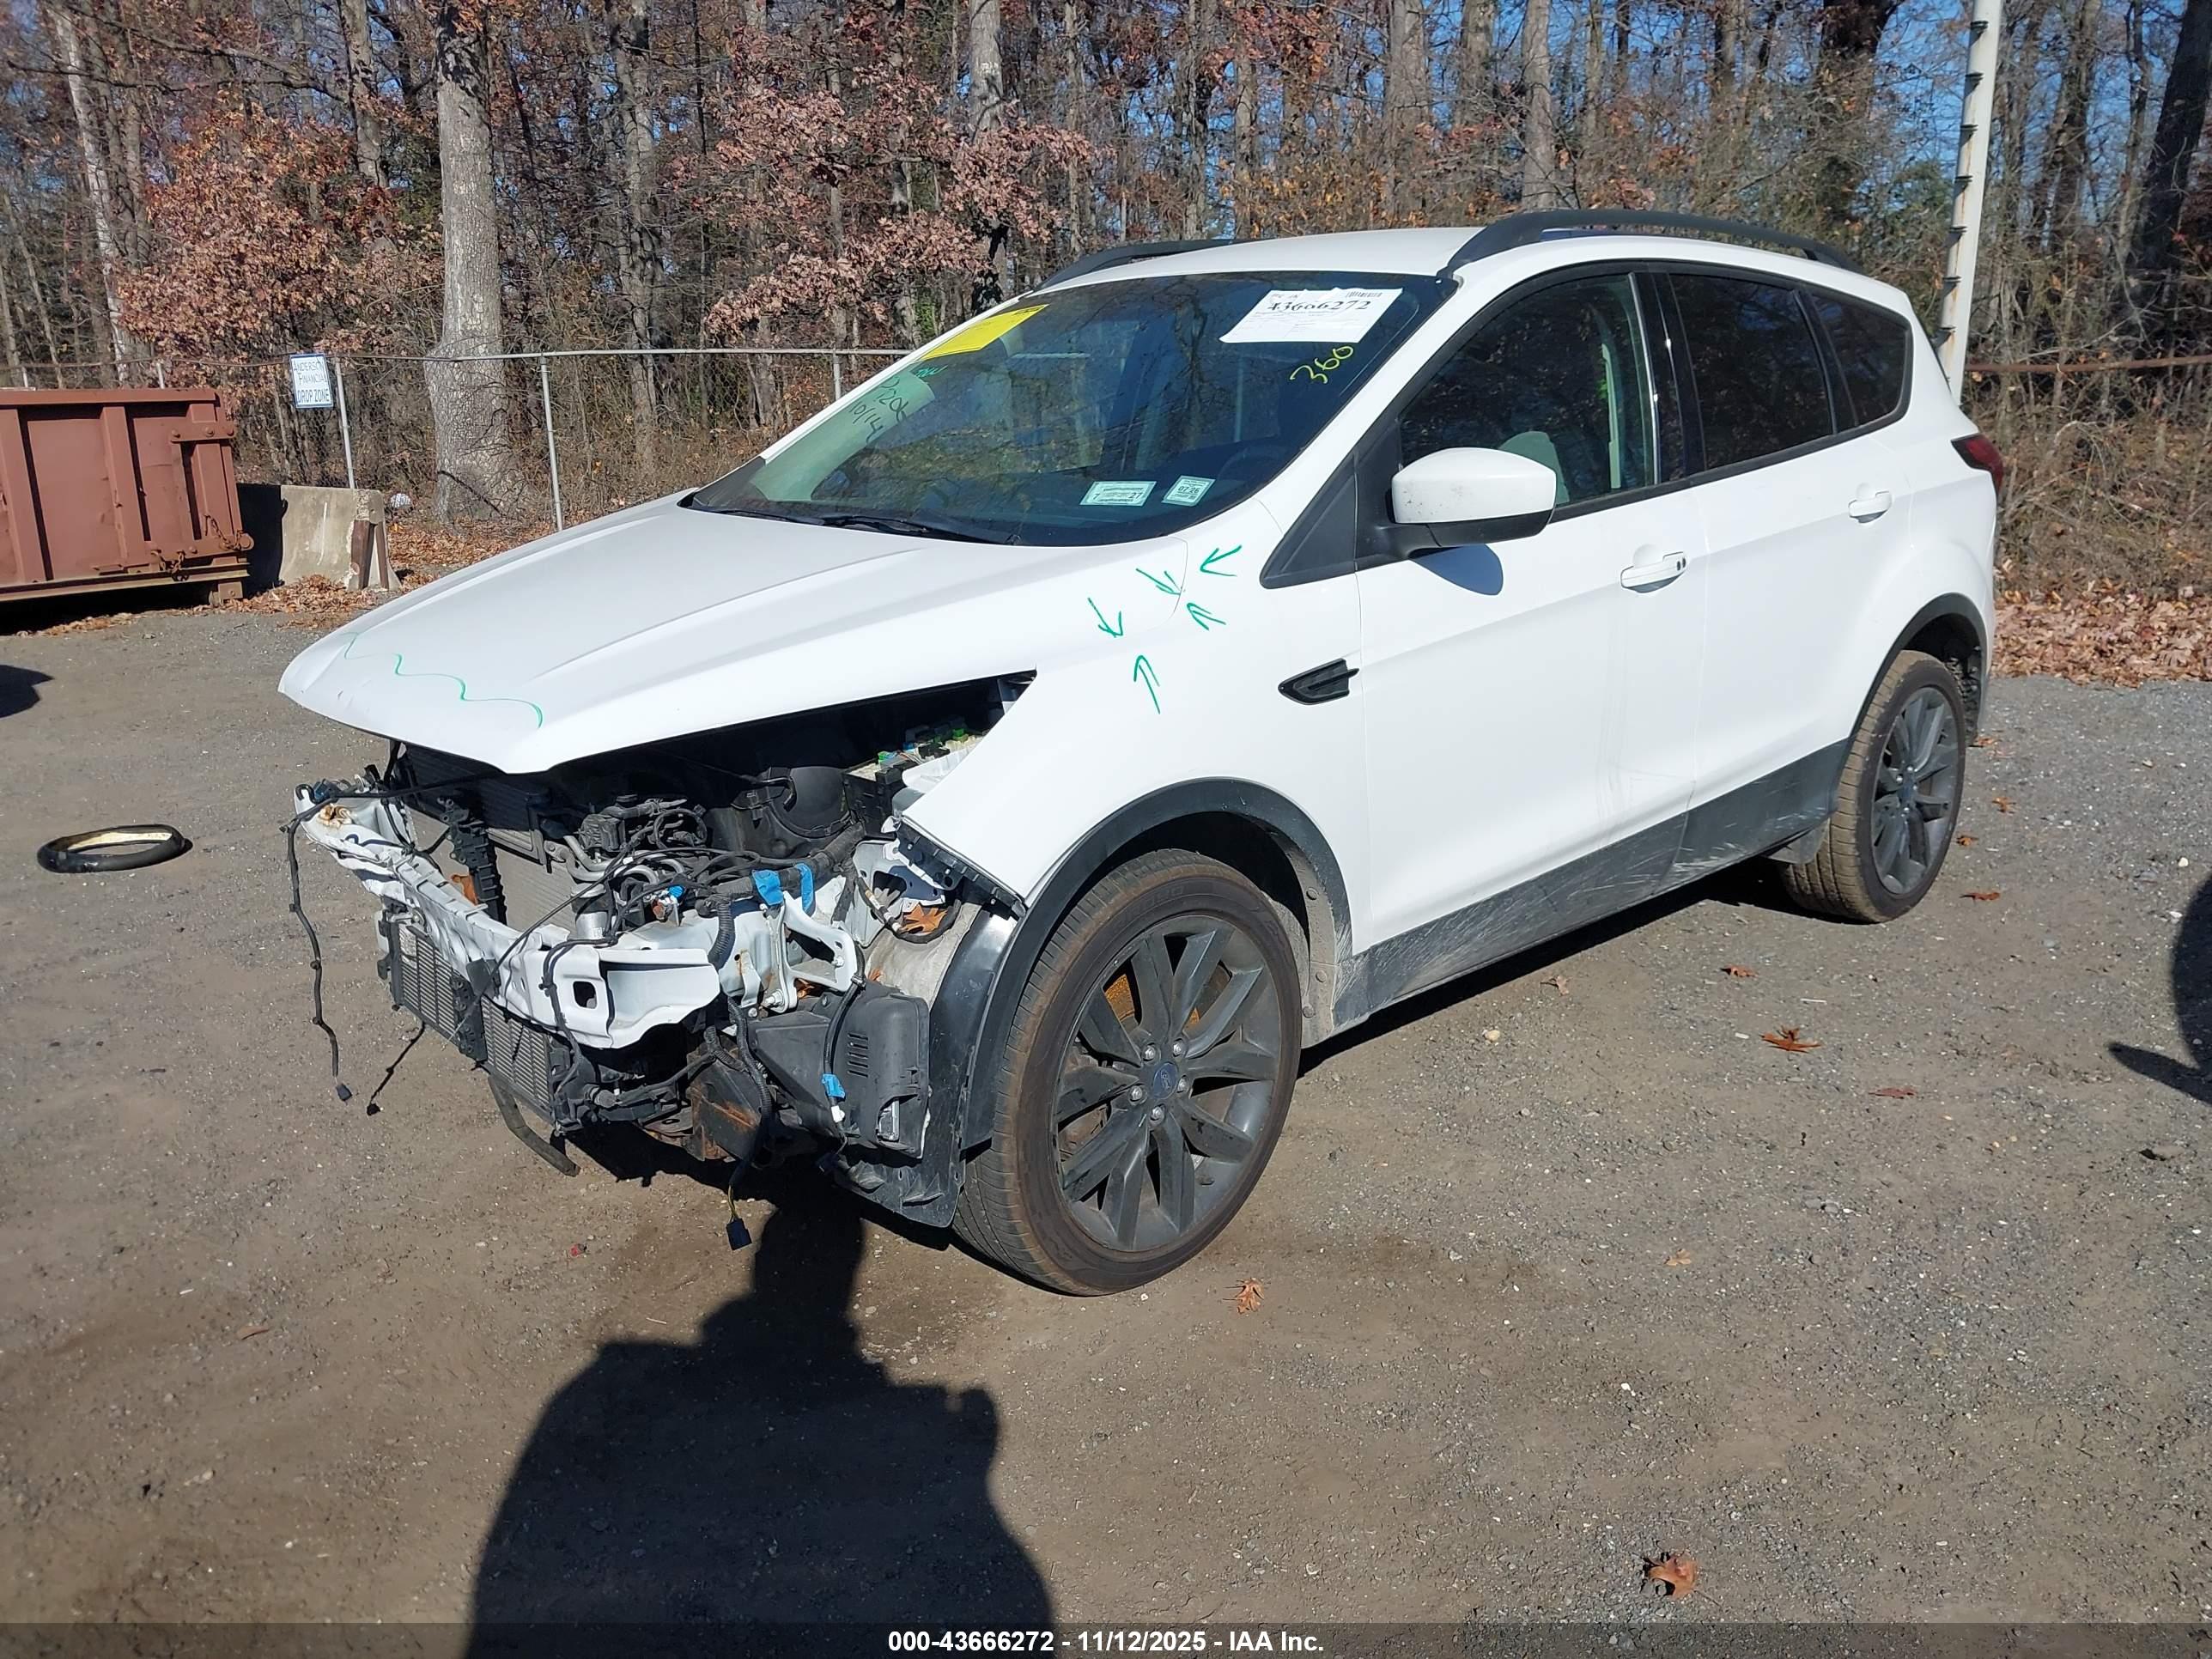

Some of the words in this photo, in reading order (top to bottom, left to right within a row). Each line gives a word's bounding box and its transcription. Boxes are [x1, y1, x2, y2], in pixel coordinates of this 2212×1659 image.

[1290, 345, 1354, 384] 360
[297, 389, 313, 403] DROP
[313, 388, 330, 402] ZONE
